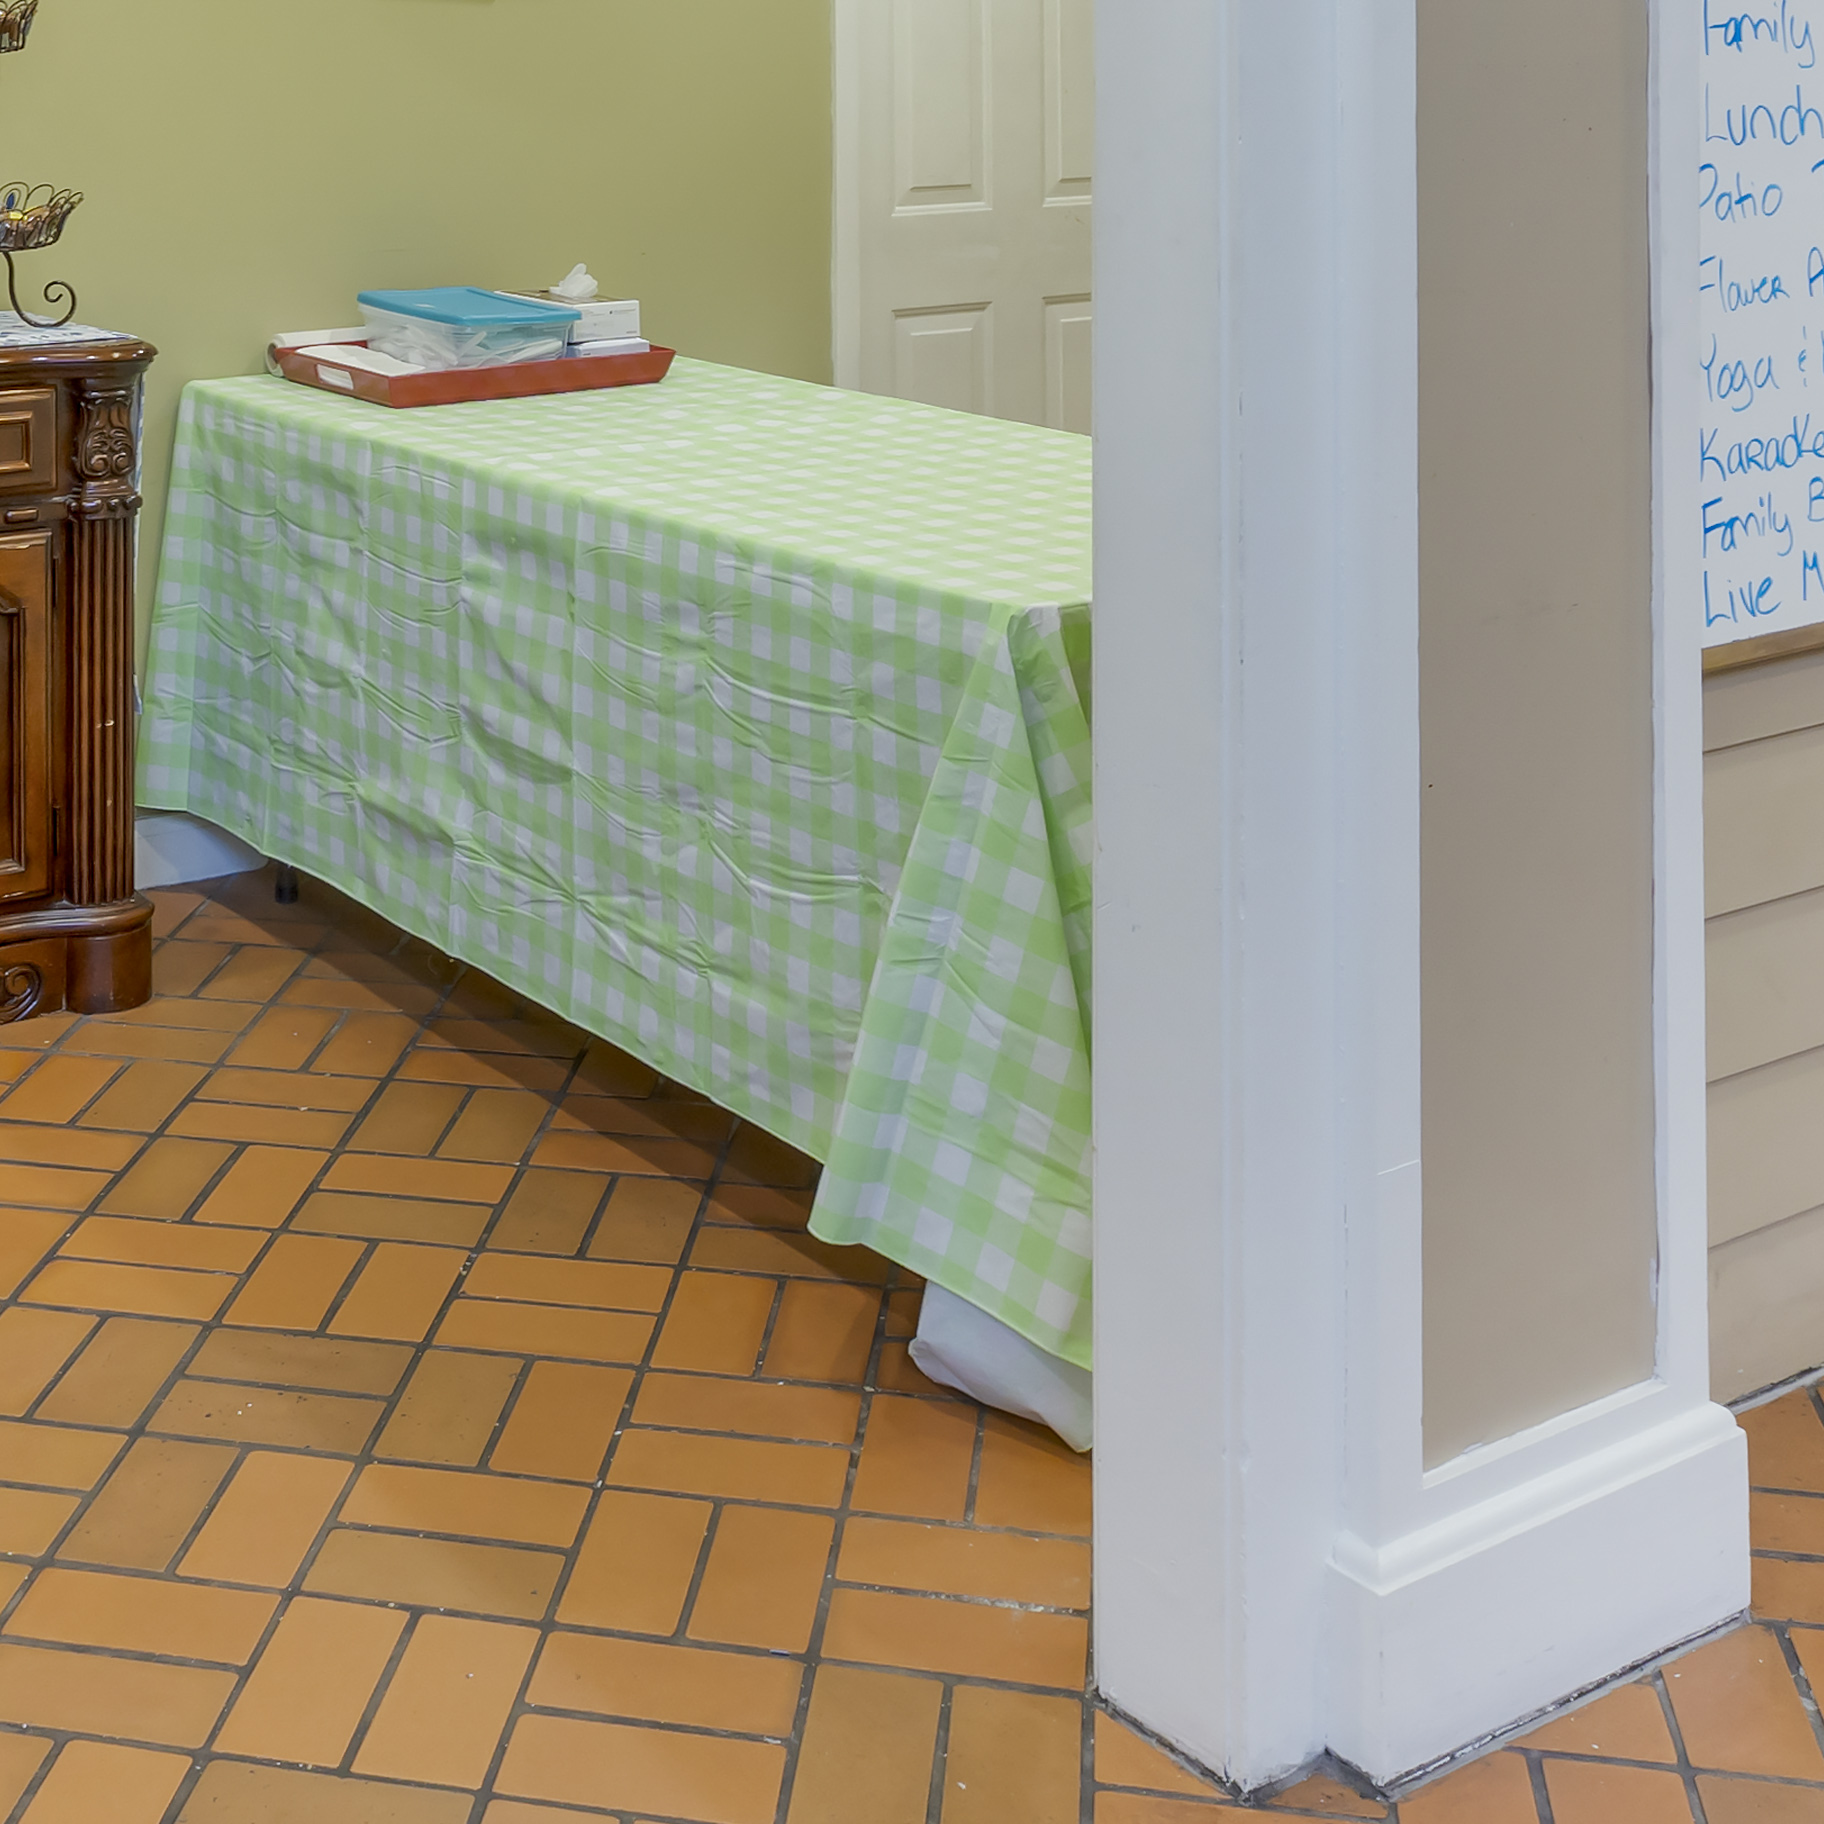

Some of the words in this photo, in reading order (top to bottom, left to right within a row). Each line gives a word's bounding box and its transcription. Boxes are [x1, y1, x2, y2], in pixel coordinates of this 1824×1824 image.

[1705, 82, 1824, 145] Lunch
[1700, 333, 1779, 412] Yoga
[1702, 491, 1793, 558] Family
[1704, 570, 1781, 627] Live
